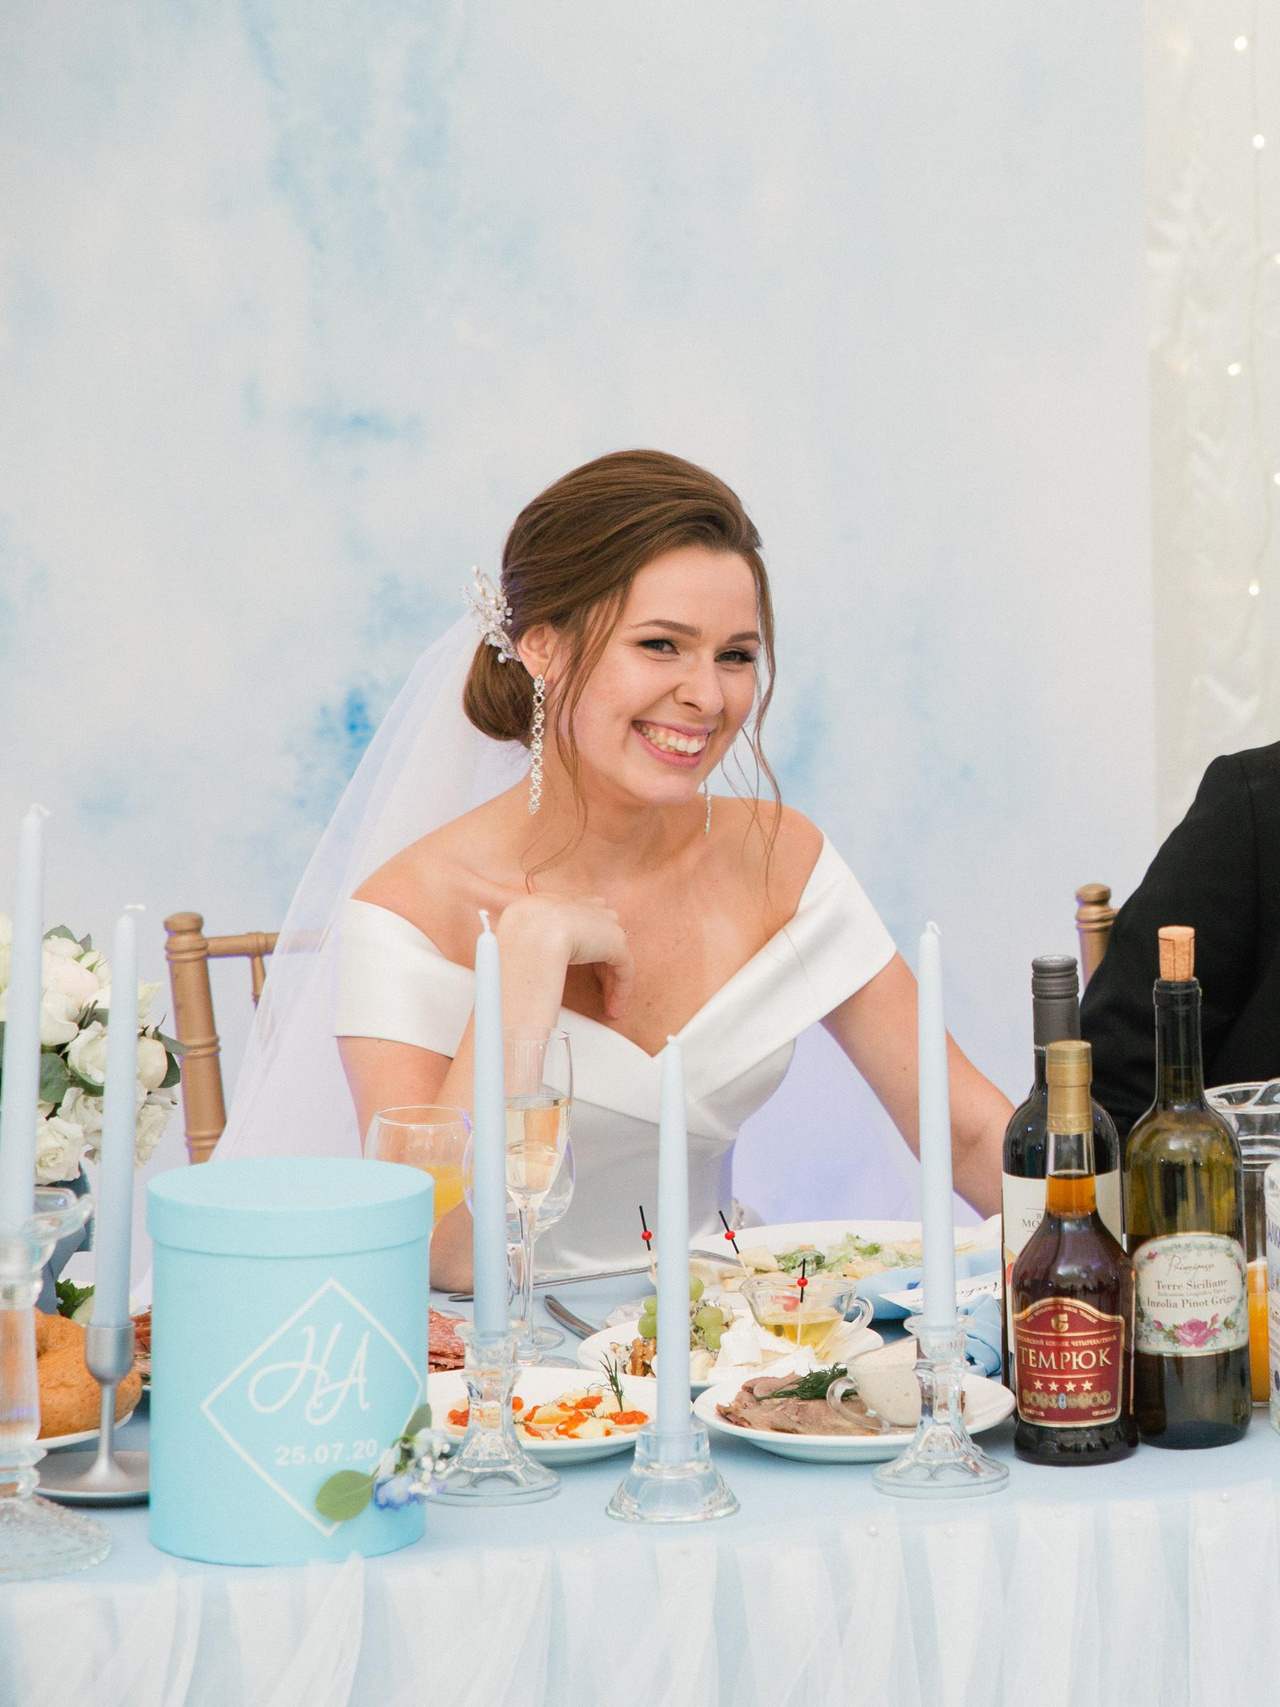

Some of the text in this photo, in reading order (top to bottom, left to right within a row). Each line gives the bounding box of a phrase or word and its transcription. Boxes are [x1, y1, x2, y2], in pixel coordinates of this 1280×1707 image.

[1156, 1279, 1228, 1290] Terre Siciliane
[1147, 1294, 1237, 1309] Inzolia Pinot Grigio
[1019, 1346, 1113, 1370] ТЕМРЮК
[275, 1438, 379, 1466] 25.07.20
